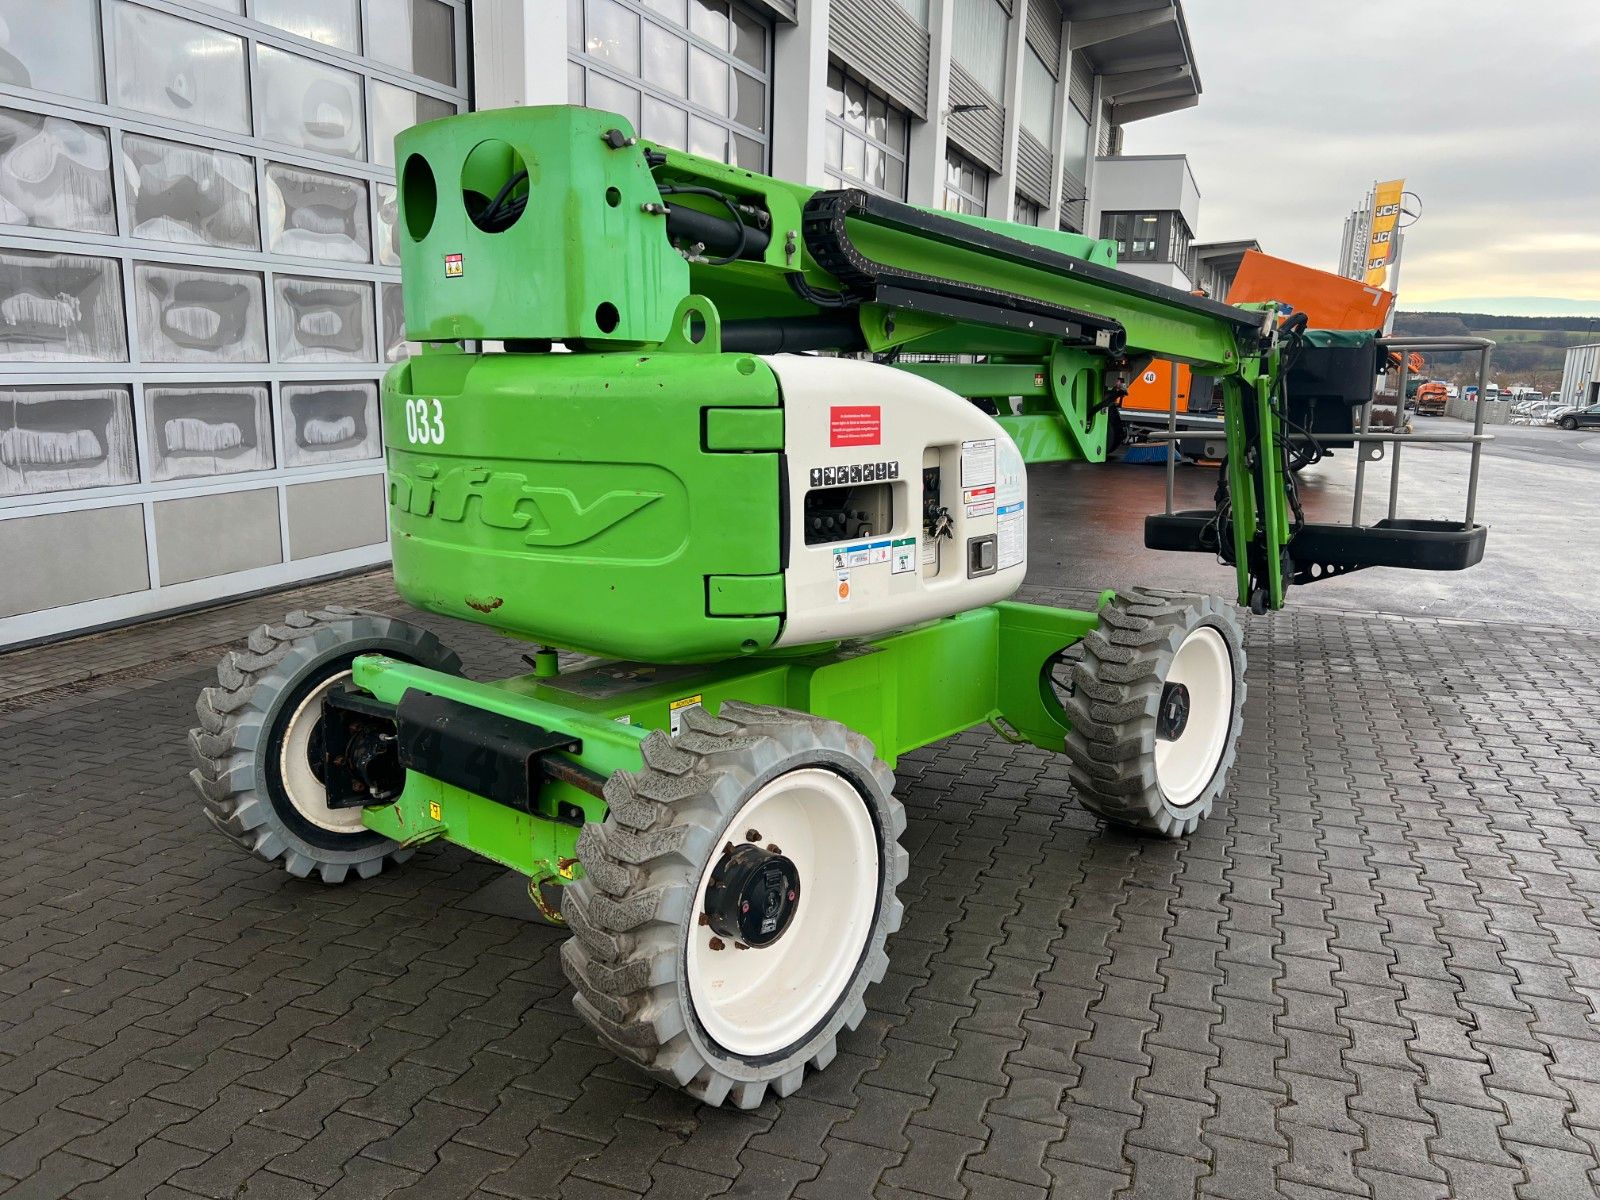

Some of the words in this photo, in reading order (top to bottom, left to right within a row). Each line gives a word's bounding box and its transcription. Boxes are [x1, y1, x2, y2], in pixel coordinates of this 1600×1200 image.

[1376, 204, 1399, 217] JCB
[1145, 373, 1154, 382] 40
[405, 398, 445, 445] 033
